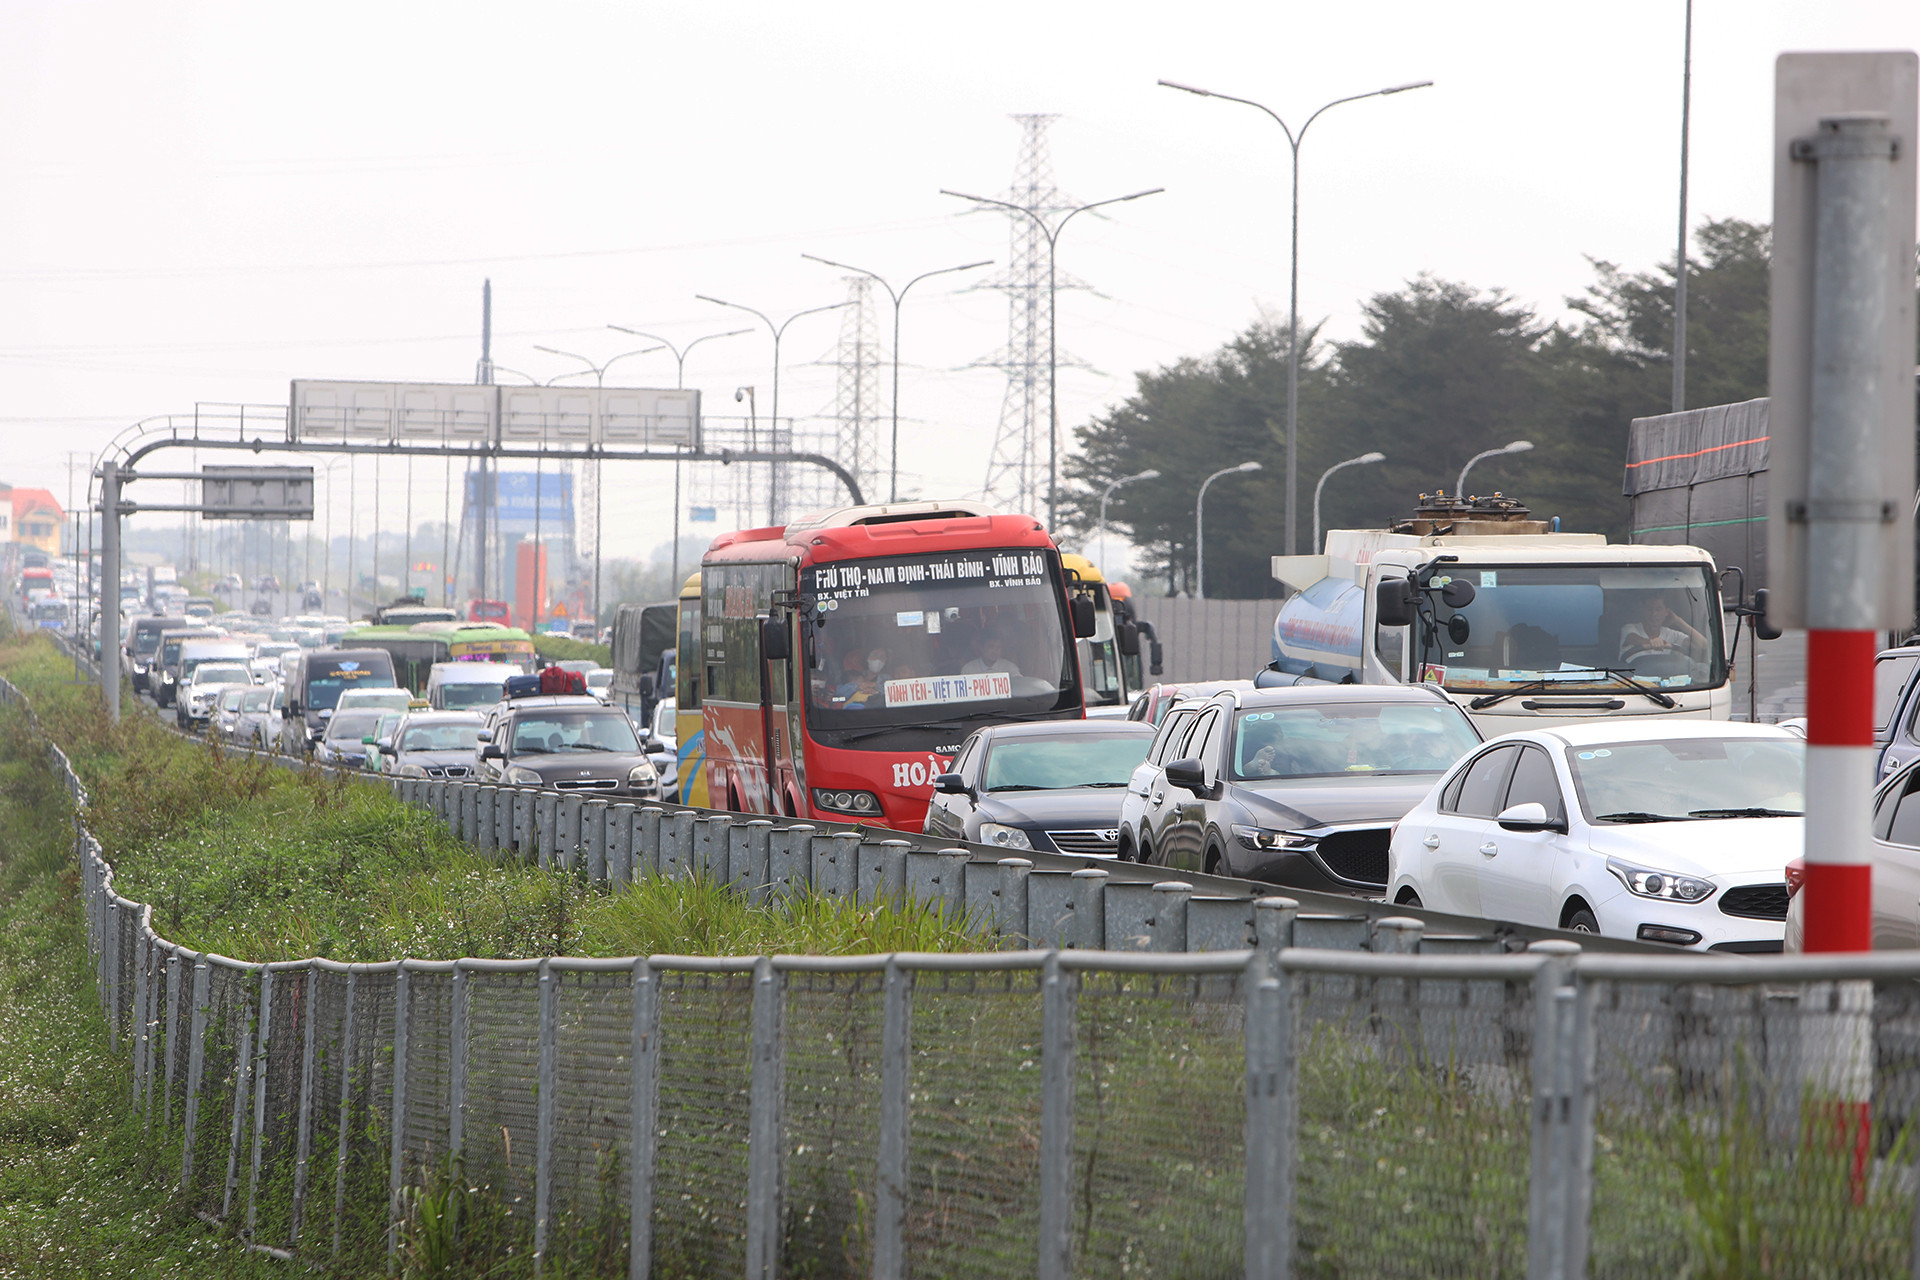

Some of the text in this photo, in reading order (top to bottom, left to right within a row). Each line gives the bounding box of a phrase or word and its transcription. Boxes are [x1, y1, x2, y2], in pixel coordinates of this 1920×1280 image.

[815, 564, 838, 589] PHÚ
[957, 557, 984, 578] BÌNH
[992, 553, 1019, 576] VĨNH
[1021, 551, 1044, 575] BẢO
[988, 575, 1042, 588] BX. VĨNH BẢO
[817, 587, 869, 600] BX. VIỆT TRÌ
[887, 682, 908, 703] VĨNH
[992, 677, 1010, 698] THỌ
